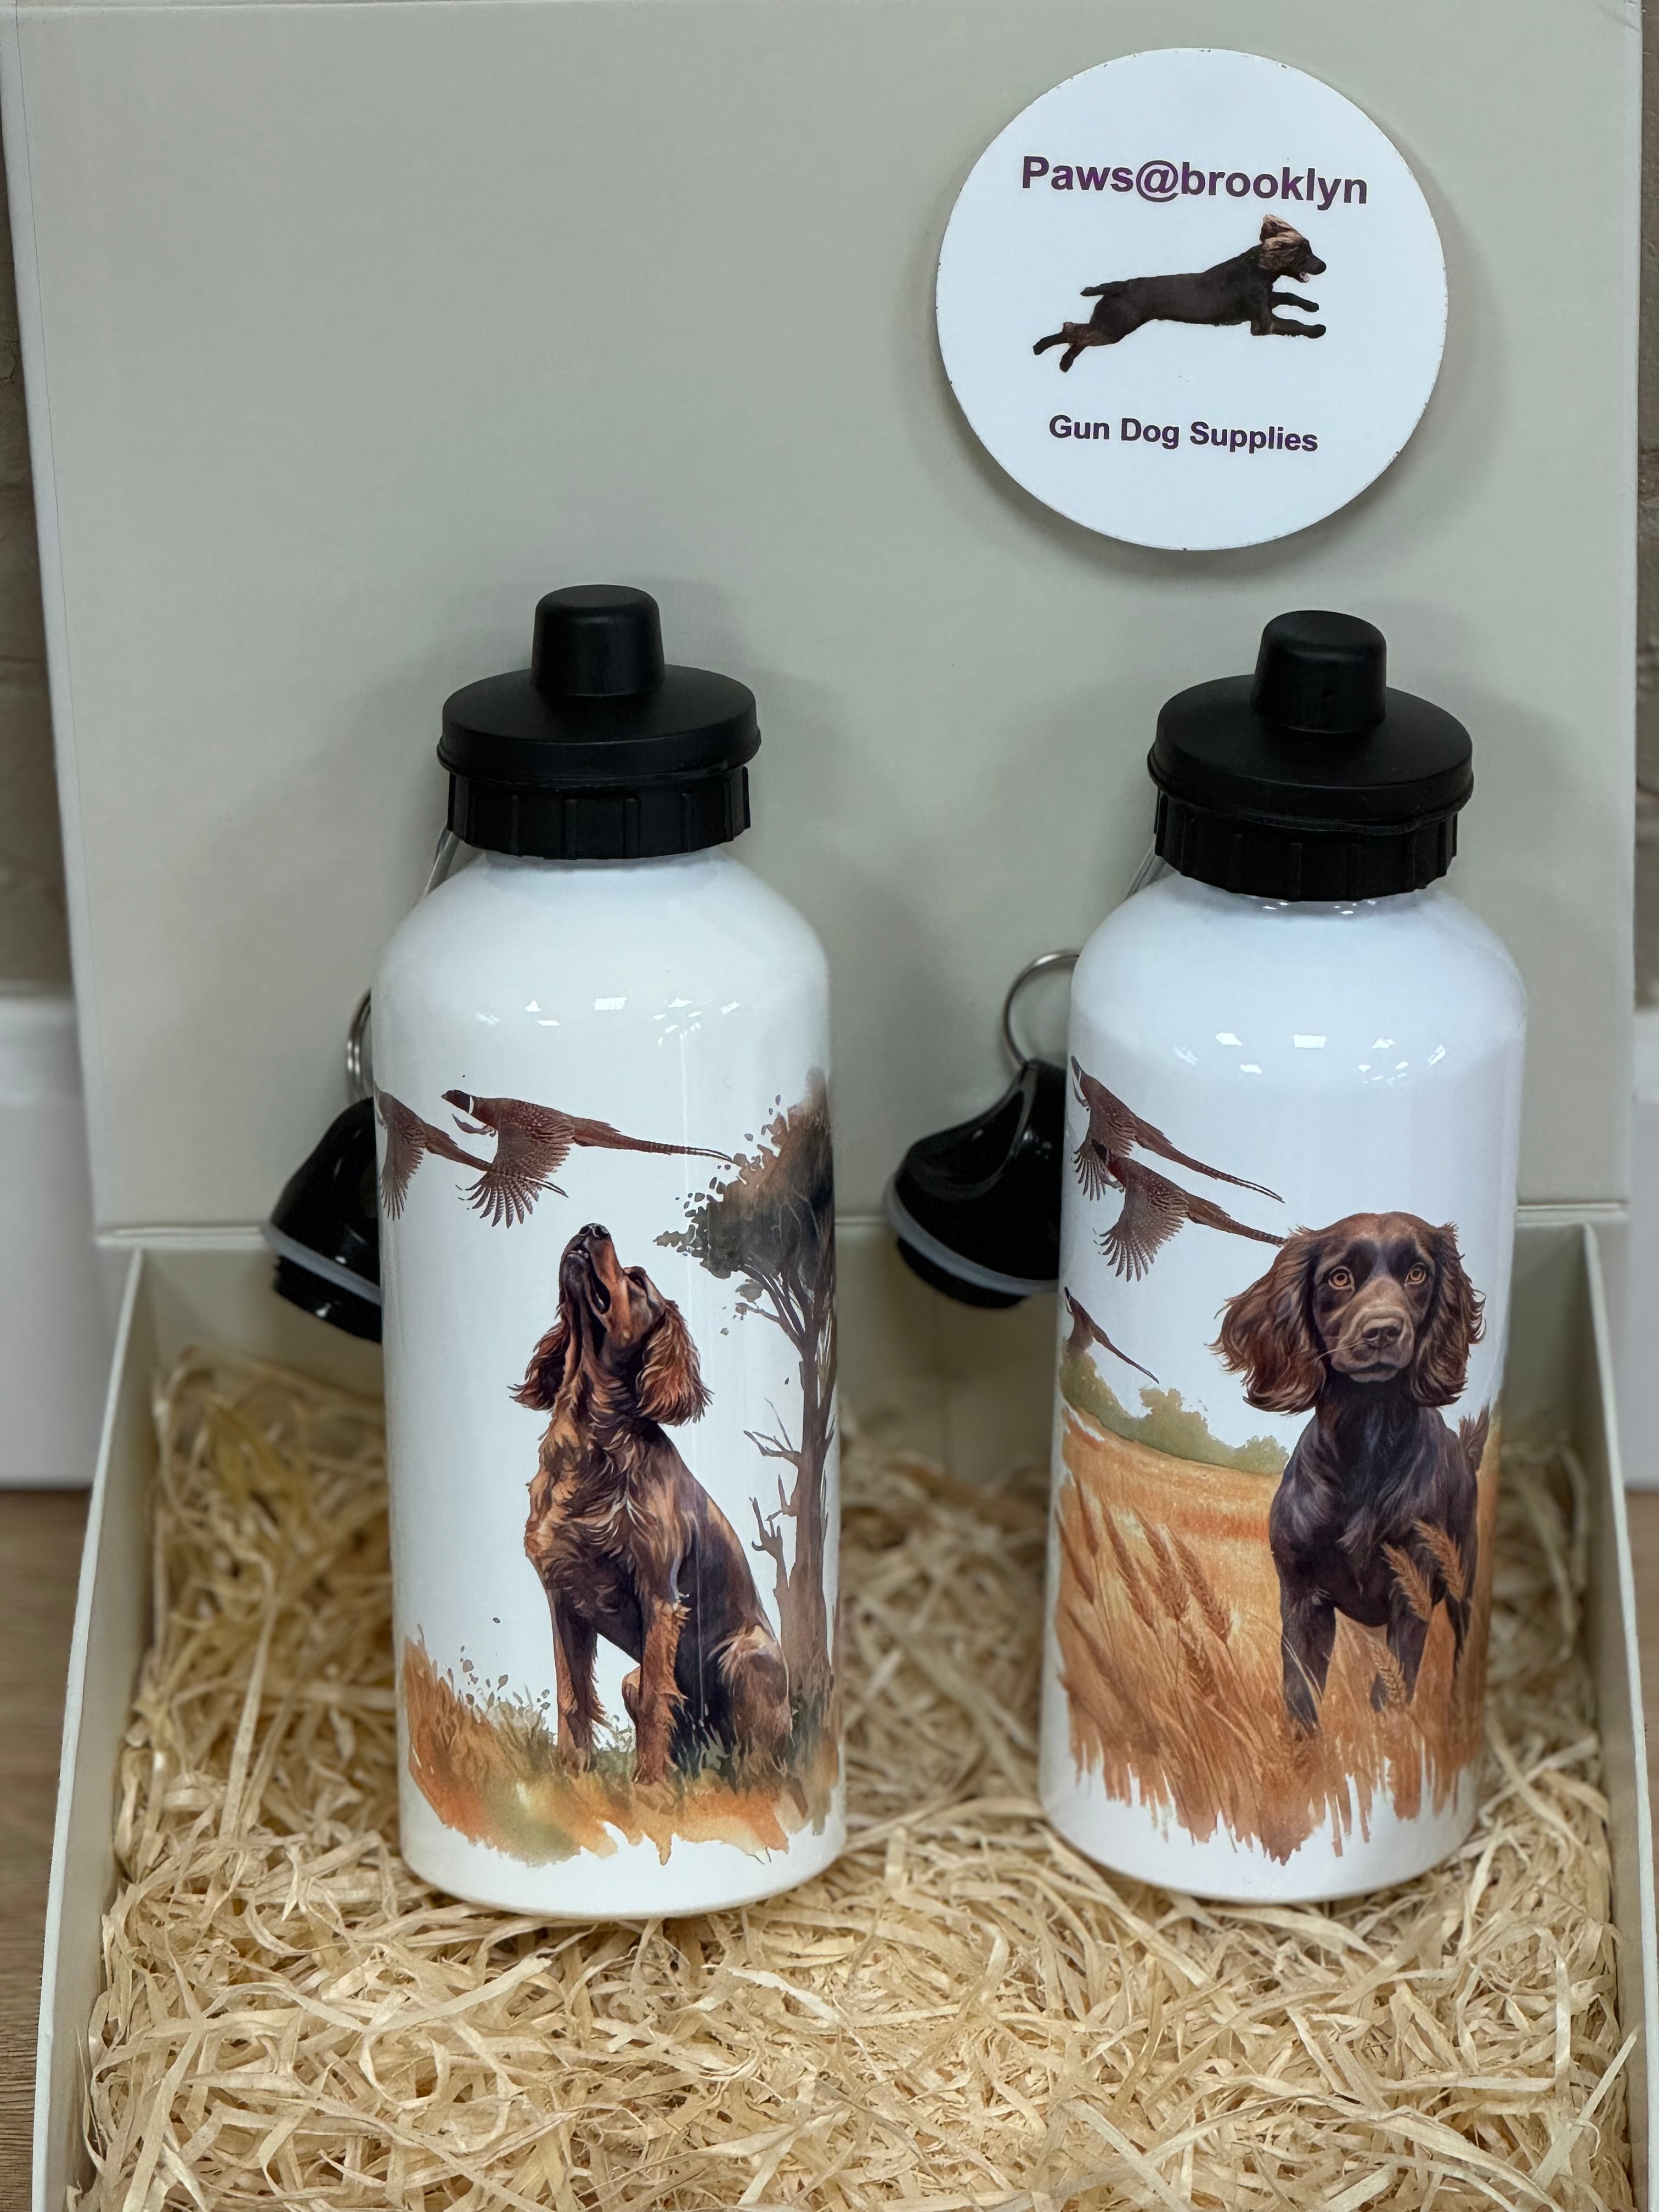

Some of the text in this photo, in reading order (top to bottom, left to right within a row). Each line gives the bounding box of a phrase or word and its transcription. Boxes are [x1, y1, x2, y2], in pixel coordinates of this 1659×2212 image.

[1022, 155, 1368, 212] Paws@brooklyn
[1048, 414, 1319, 455] Gun Dog Supplies
